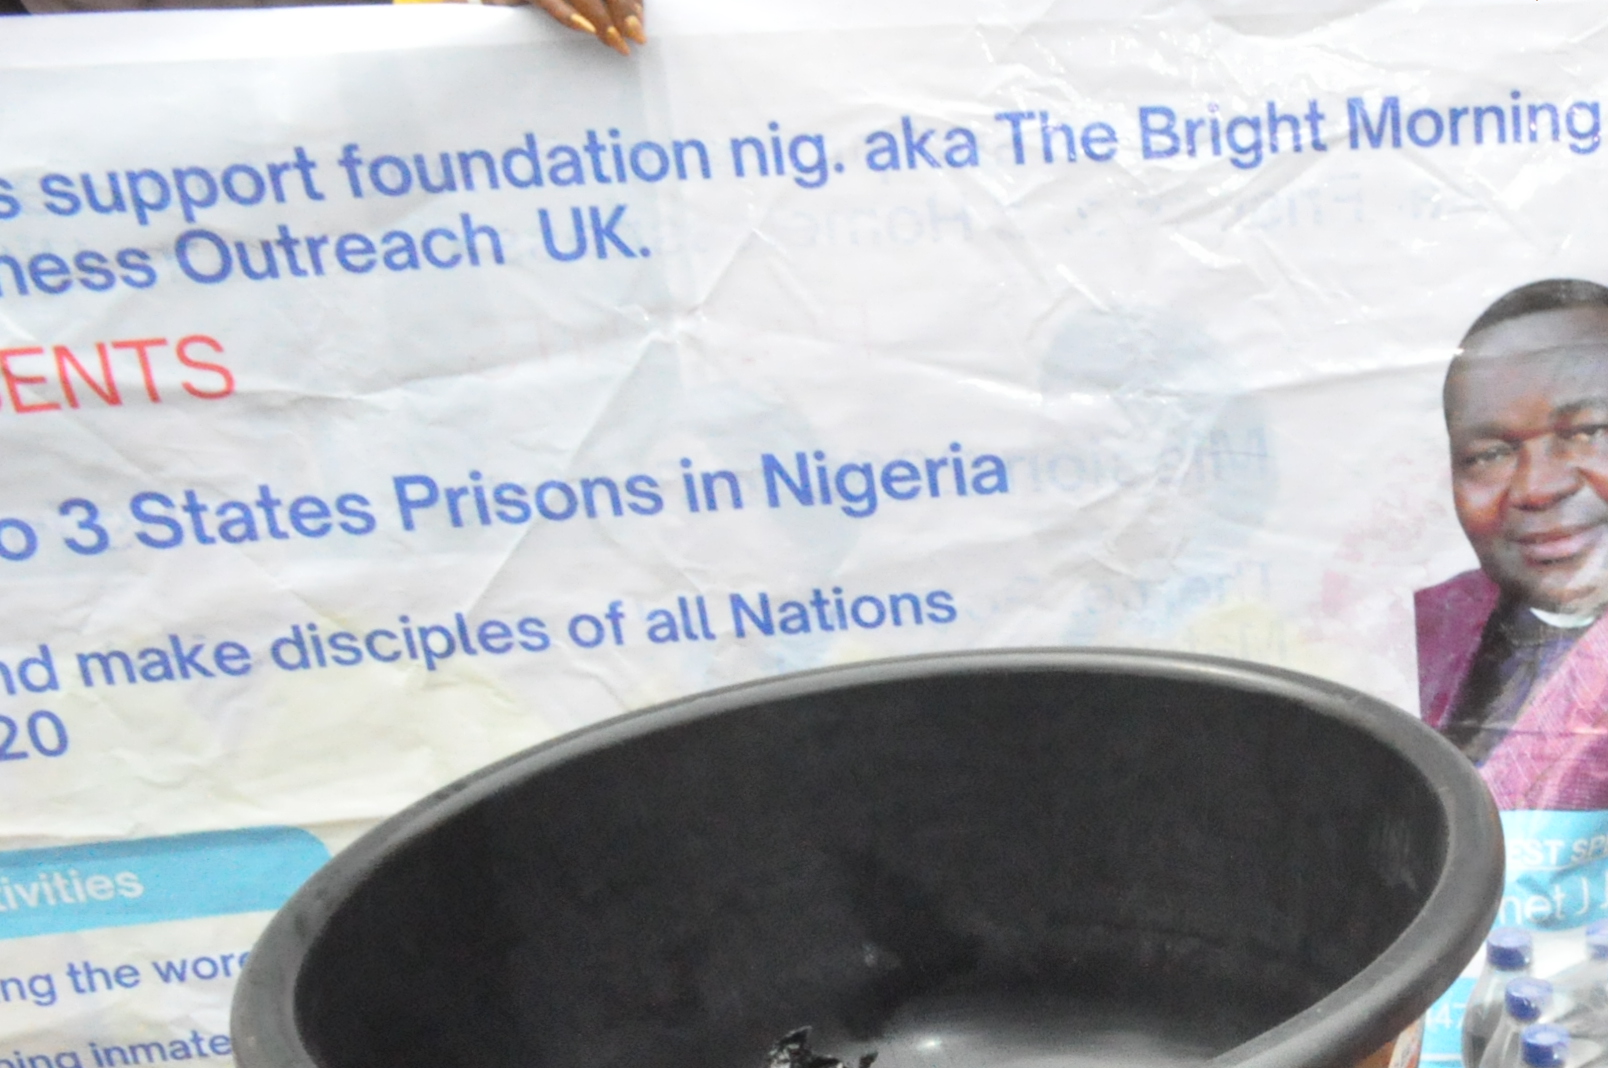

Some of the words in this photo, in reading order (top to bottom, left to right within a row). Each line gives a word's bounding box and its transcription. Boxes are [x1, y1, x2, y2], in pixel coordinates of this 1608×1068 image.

[42, 147, 325, 227] support
[339, 129, 711, 198] foundation
[730, 122, 845, 189] nig.
[866, 115, 980, 172] aka
[995, 110, 1118, 166] The
[1138, 101, 1328, 170] Bright
[1347, 90, 1602, 155] Morning
[174, 212, 505, 285] Outreach
[538, 204, 651, 262] UK.
[0, 335, 235, 414] ENTS
[58, 498, 110, 556] 3
[129, 486, 377, 550] States
[393, 472, 664, 532] Prisons
[680, 457, 744, 513] in
[761, 443, 1009, 519] Nigeria
[76, 636, 252, 687] make
[270, 611, 553, 672] disciples
[568, 601, 625, 648] of
[646, 596, 716, 643] all
[730, 587, 958, 638] Nations
[66, 961, 140, 995] the
